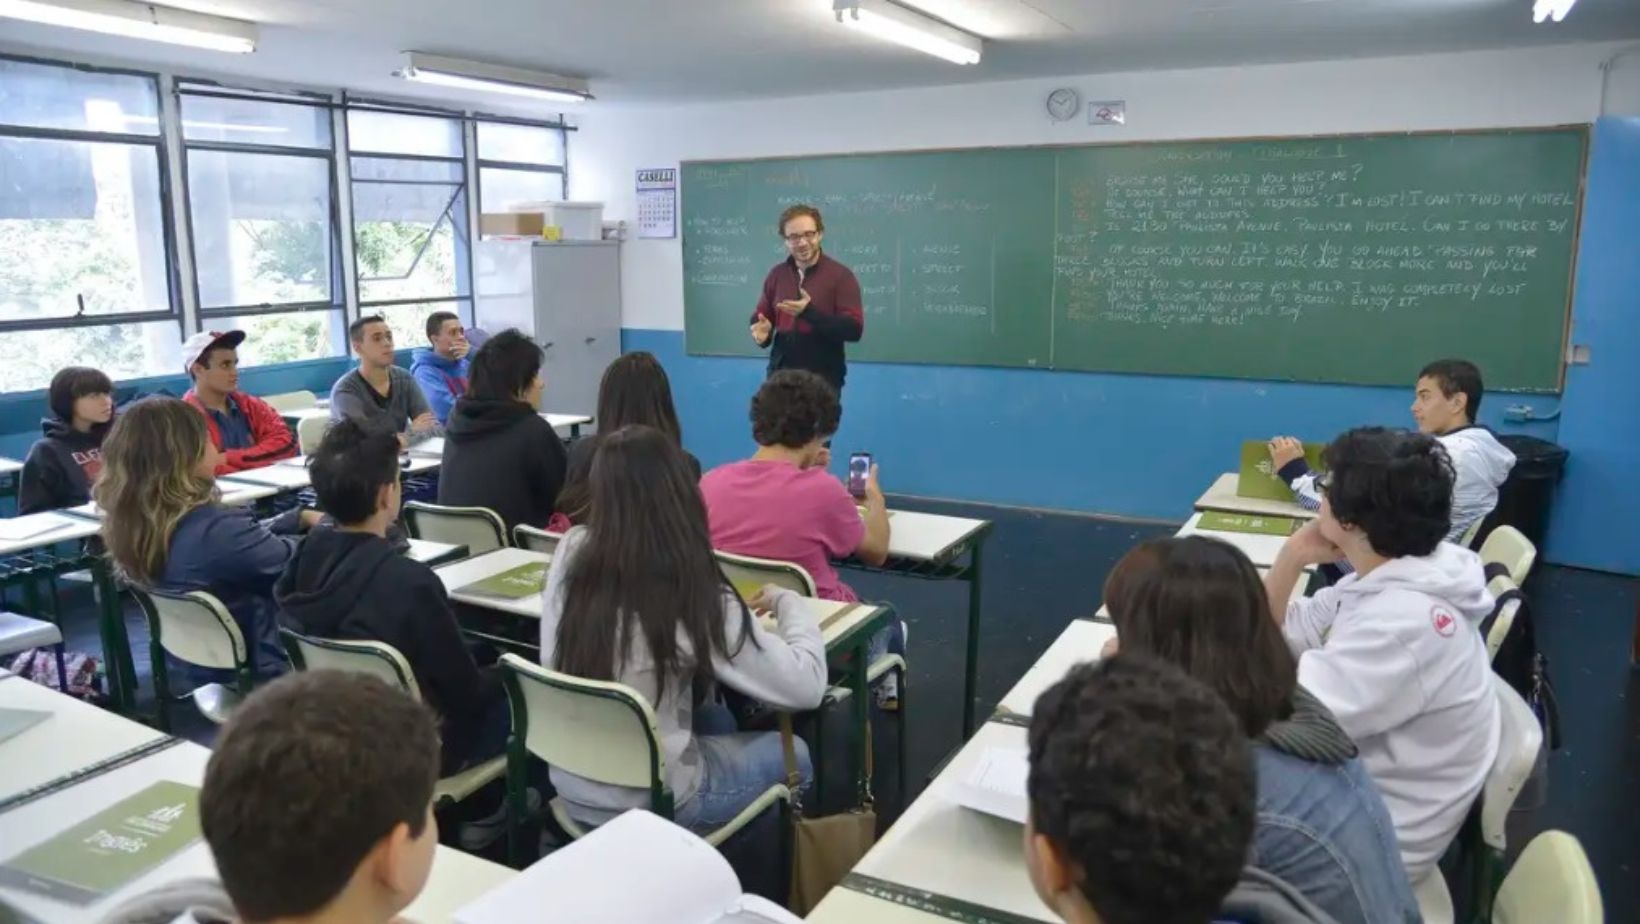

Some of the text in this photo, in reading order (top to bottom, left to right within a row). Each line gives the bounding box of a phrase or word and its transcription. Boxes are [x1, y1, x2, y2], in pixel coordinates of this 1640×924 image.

[638, 171, 674, 183] CASELLI
[1261, 170, 1284, 185] YOU
[1291, 170, 1325, 183] HELP
[1209, 186, 1233, 197] CAN
[1239, 185, 1249, 196] I
[1257, 184, 1287, 197] HELP
[1408, 190, 1424, 207] I
[1467, 192, 1502, 207] FIND
[1506, 191, 1528, 212] MY
[1532, 190, 1576, 207] HOTEL
[1292, 216, 1354, 233] PAULISTA
[1422, 213, 1451, 233] CAN
[1457, 219, 1470, 232] I
[1475, 220, 1491, 232] GO
[1495, 218, 1540, 232] THERE
[1546, 217, 1569, 234] BY
[1180, 243, 1204, 258] YOU
[1319, 239, 1343, 262] YOU
[1352, 245, 1371, 257] GO
[1376, 244, 1422, 257] AHEAD
[1190, 257, 1225, 267] TURN
[1350, 257, 1393, 270] BLOCK
[1399, 259, 1435, 271] MORE
[1446, 259, 1474, 271] AND
[1149, 278, 1171, 291] YOU
[1200, 280, 1233, 290] MUCH
[1238, 281, 1264, 292] FOR
[1270, 280, 1301, 297] YOUR
[1351, 281, 1363, 295] I
[1487, 280, 1528, 296] LOST
